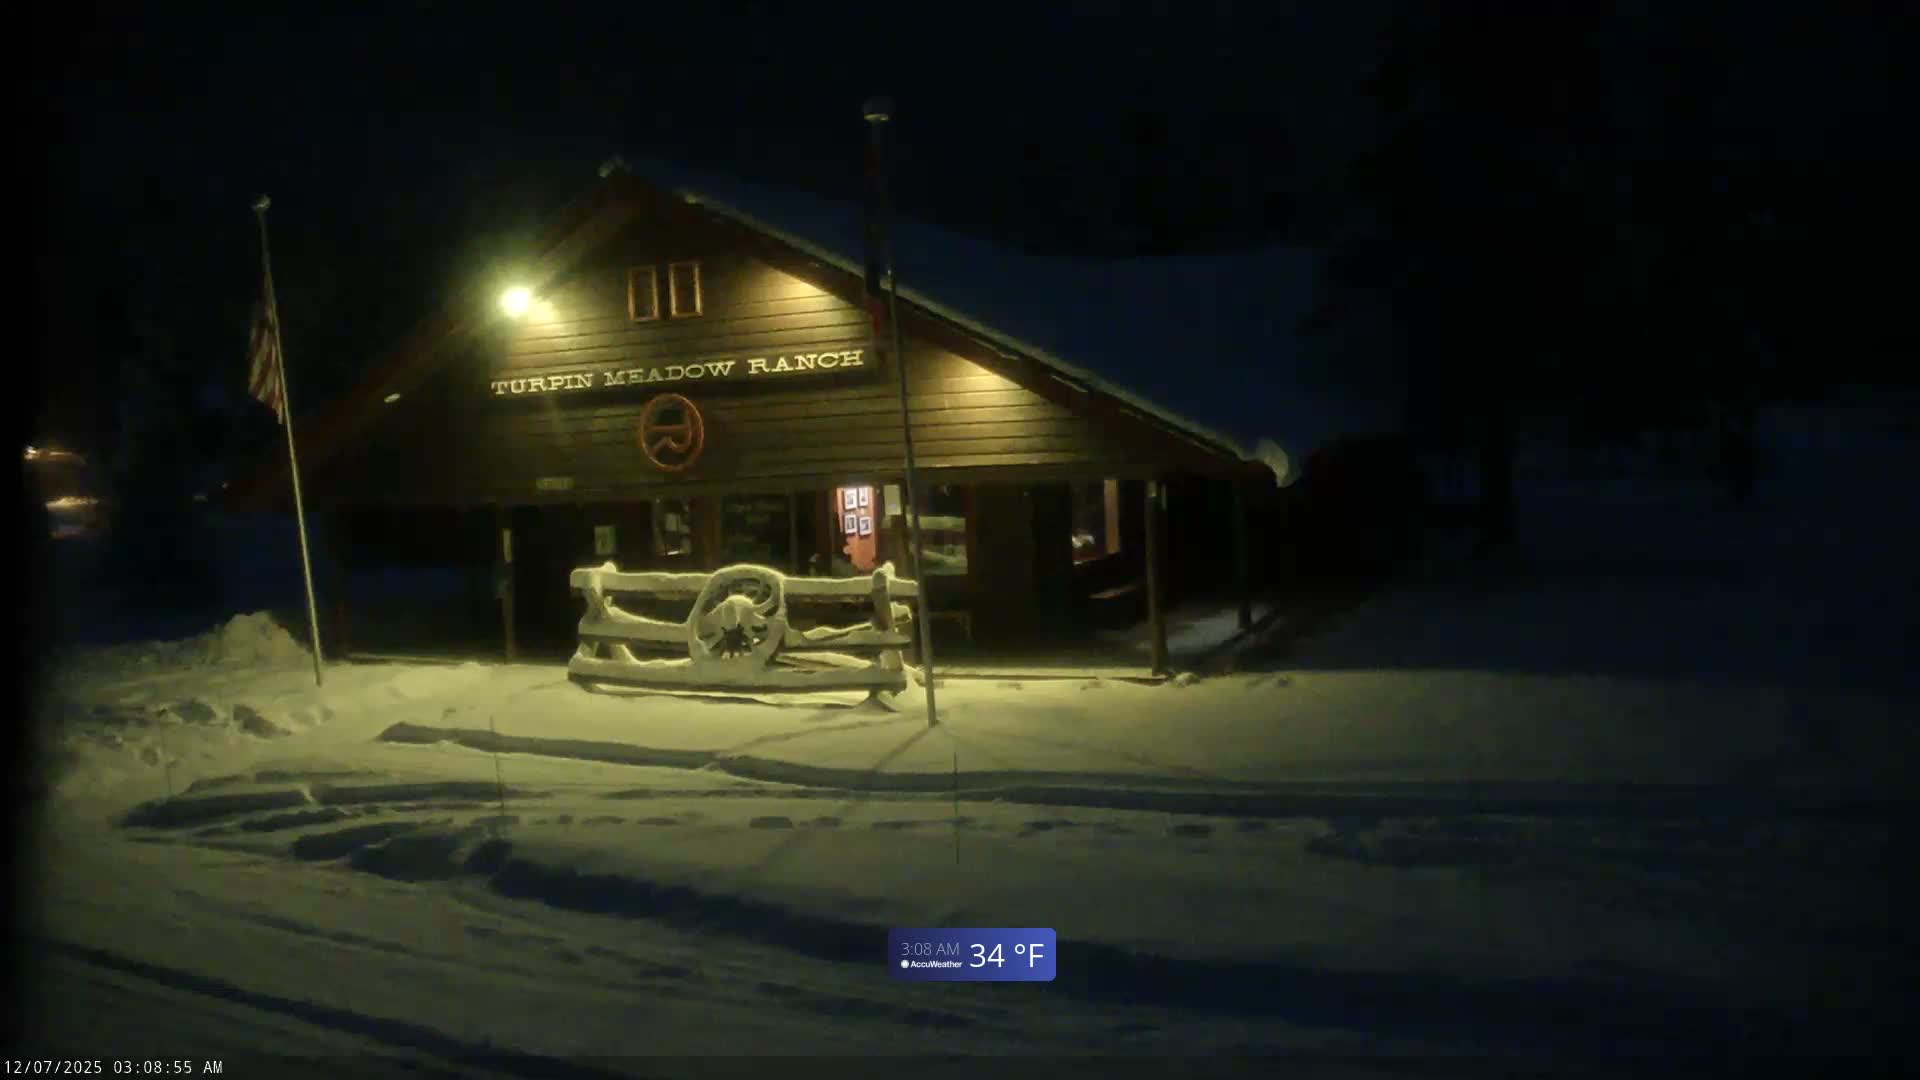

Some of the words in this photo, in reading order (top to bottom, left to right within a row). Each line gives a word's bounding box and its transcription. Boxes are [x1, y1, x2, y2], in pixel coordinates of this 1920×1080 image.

[491, 373, 594, 395] TURPIN
[603, 360, 736, 387] MEADOW
[747, 349, 865, 375] RANCH
